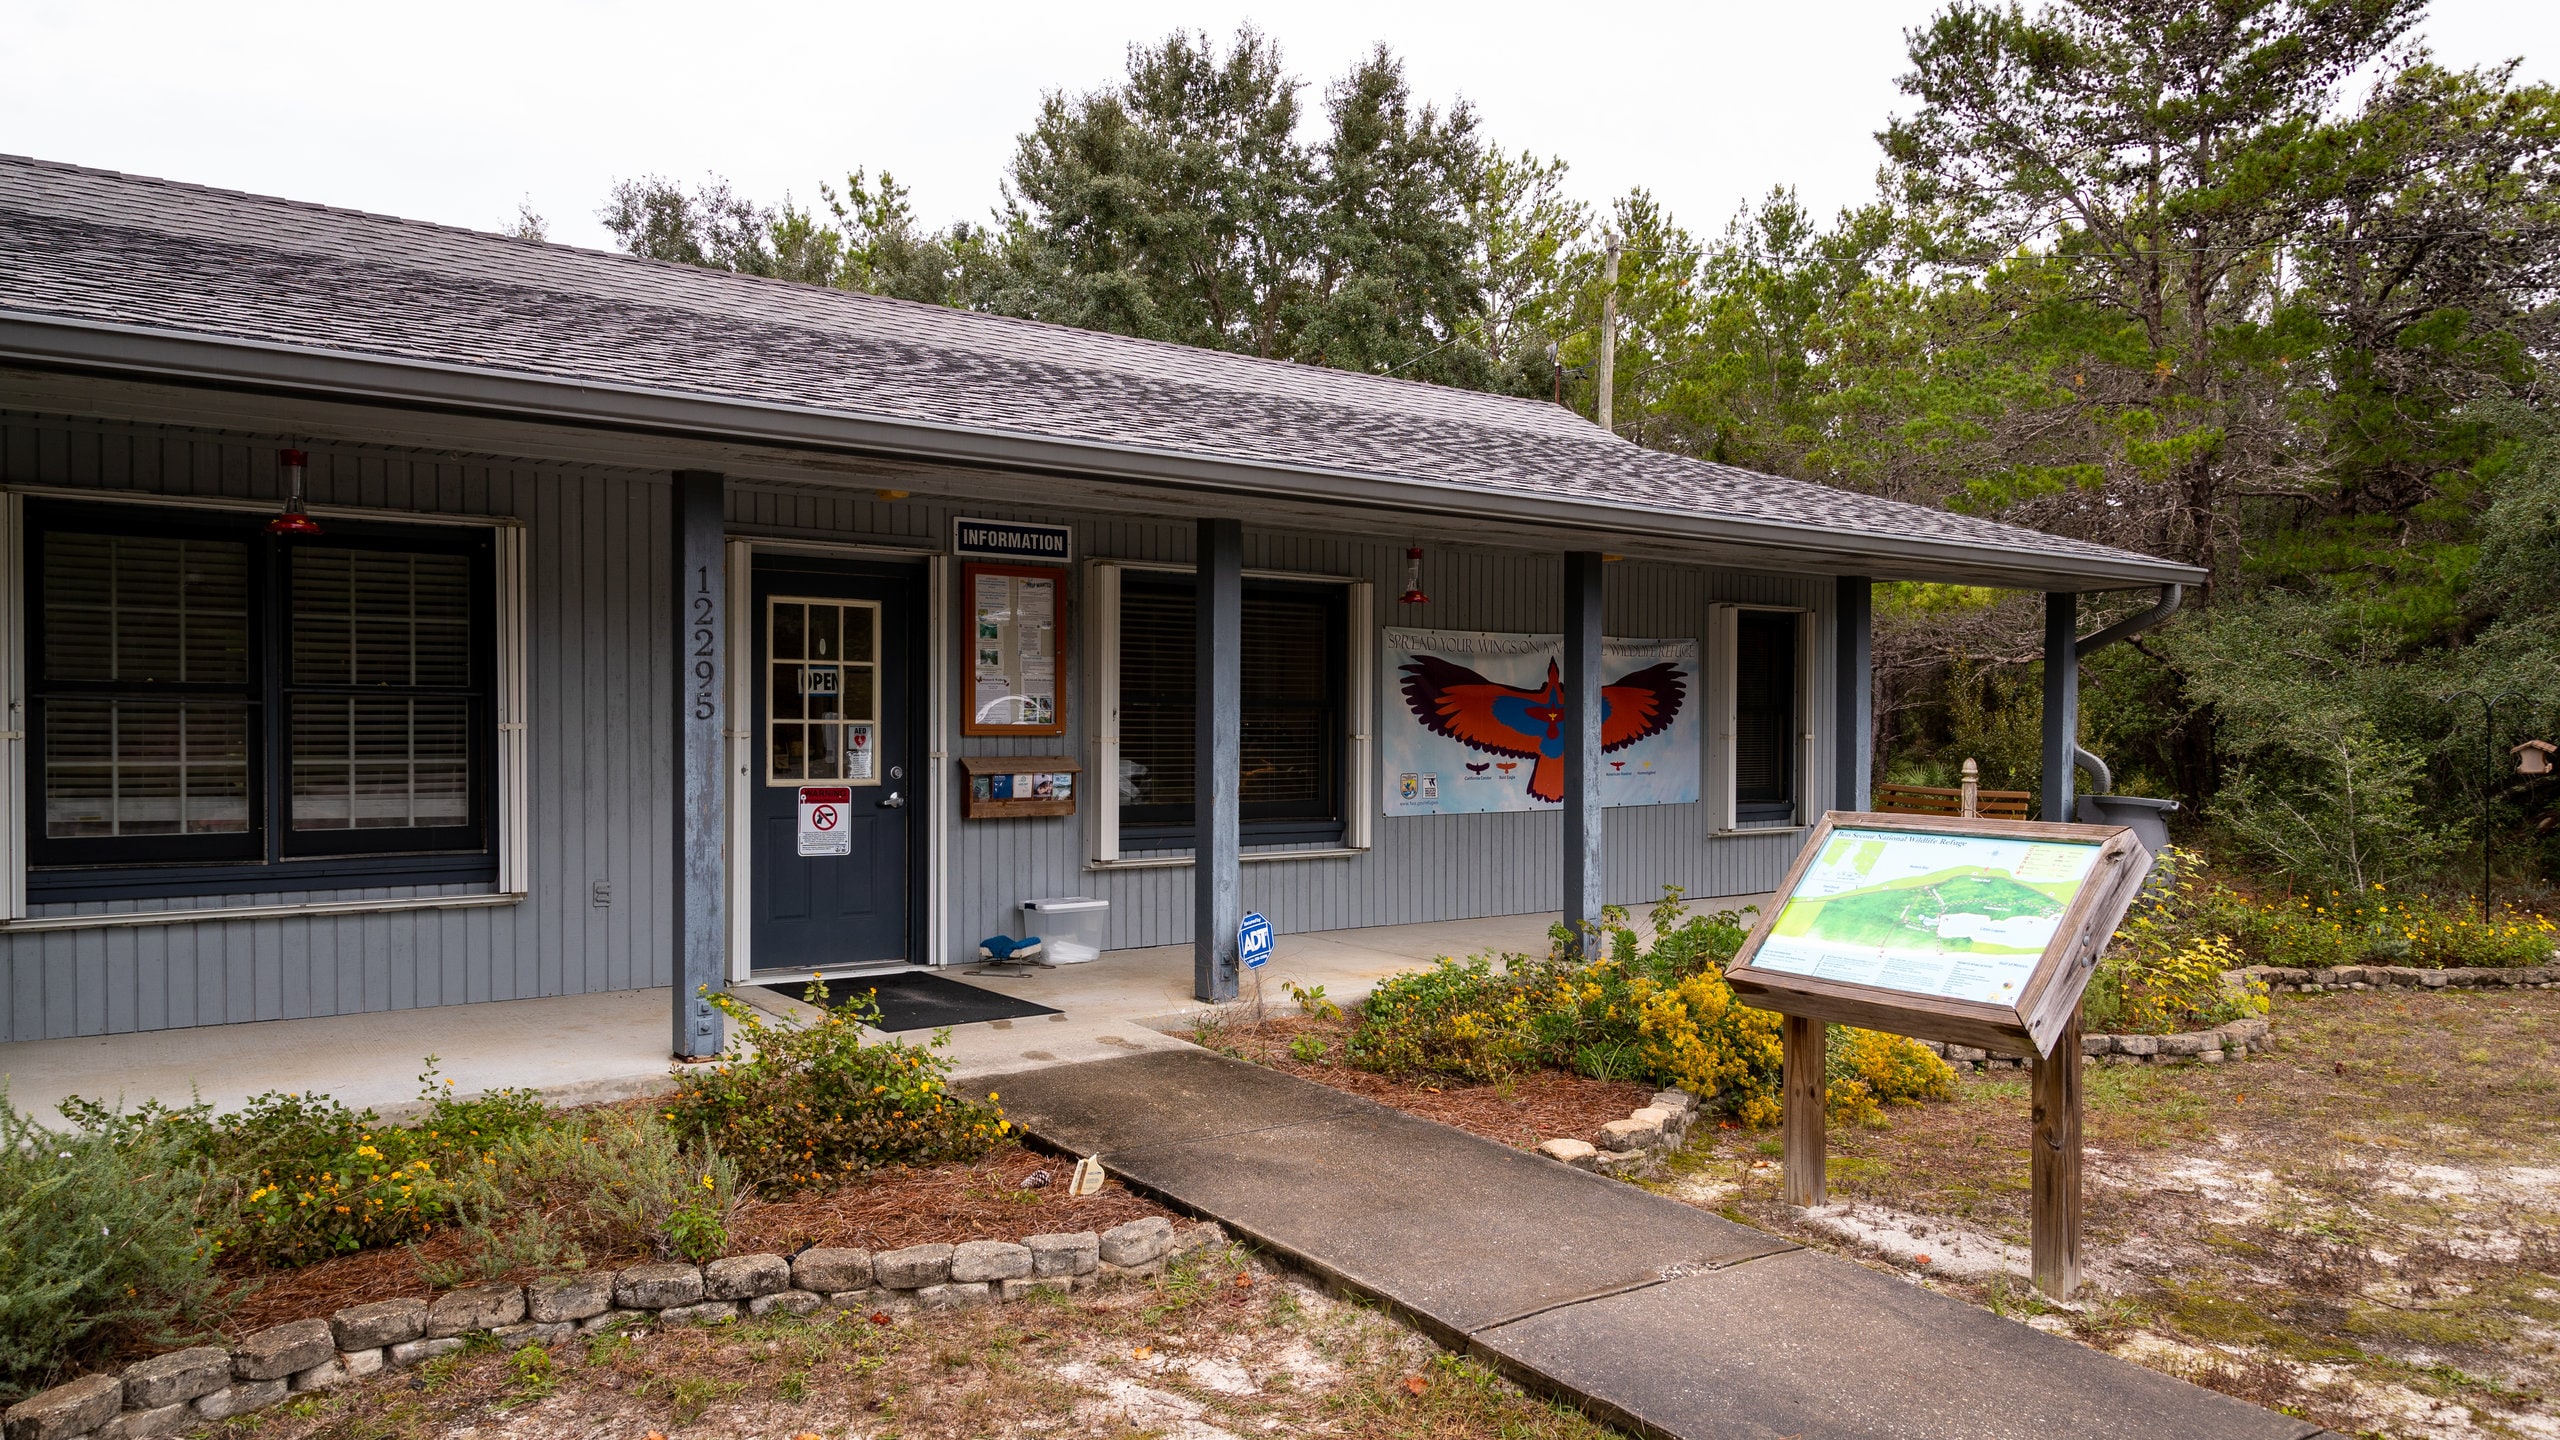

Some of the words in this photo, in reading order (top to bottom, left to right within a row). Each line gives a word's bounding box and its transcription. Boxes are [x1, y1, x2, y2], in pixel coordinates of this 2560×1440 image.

[963, 529, 1063, 551] INFORMATION
[694, 565, 715, 720] 12295
[1388, 633, 1437, 651] SPREAD
[1440, 636, 1475, 653] YOUR
[1478, 638, 1518, 654] WINGS
[1519, 640, 1540, 655] ON
[1608, 643, 1657, 658] WILDLIFE
[1658, 642, 1696, 658] REFUGE
[801, 672, 839, 691] OPEN
[804, 789, 847, 797] WARNING
[1852, 832, 1875, 840] Secour
[1877, 834, 1907, 842] National
[1909, 836, 1938, 844] Wildlife
[1939, 838, 1968, 847] Refuge
[1244, 927, 1268, 955] ADT
